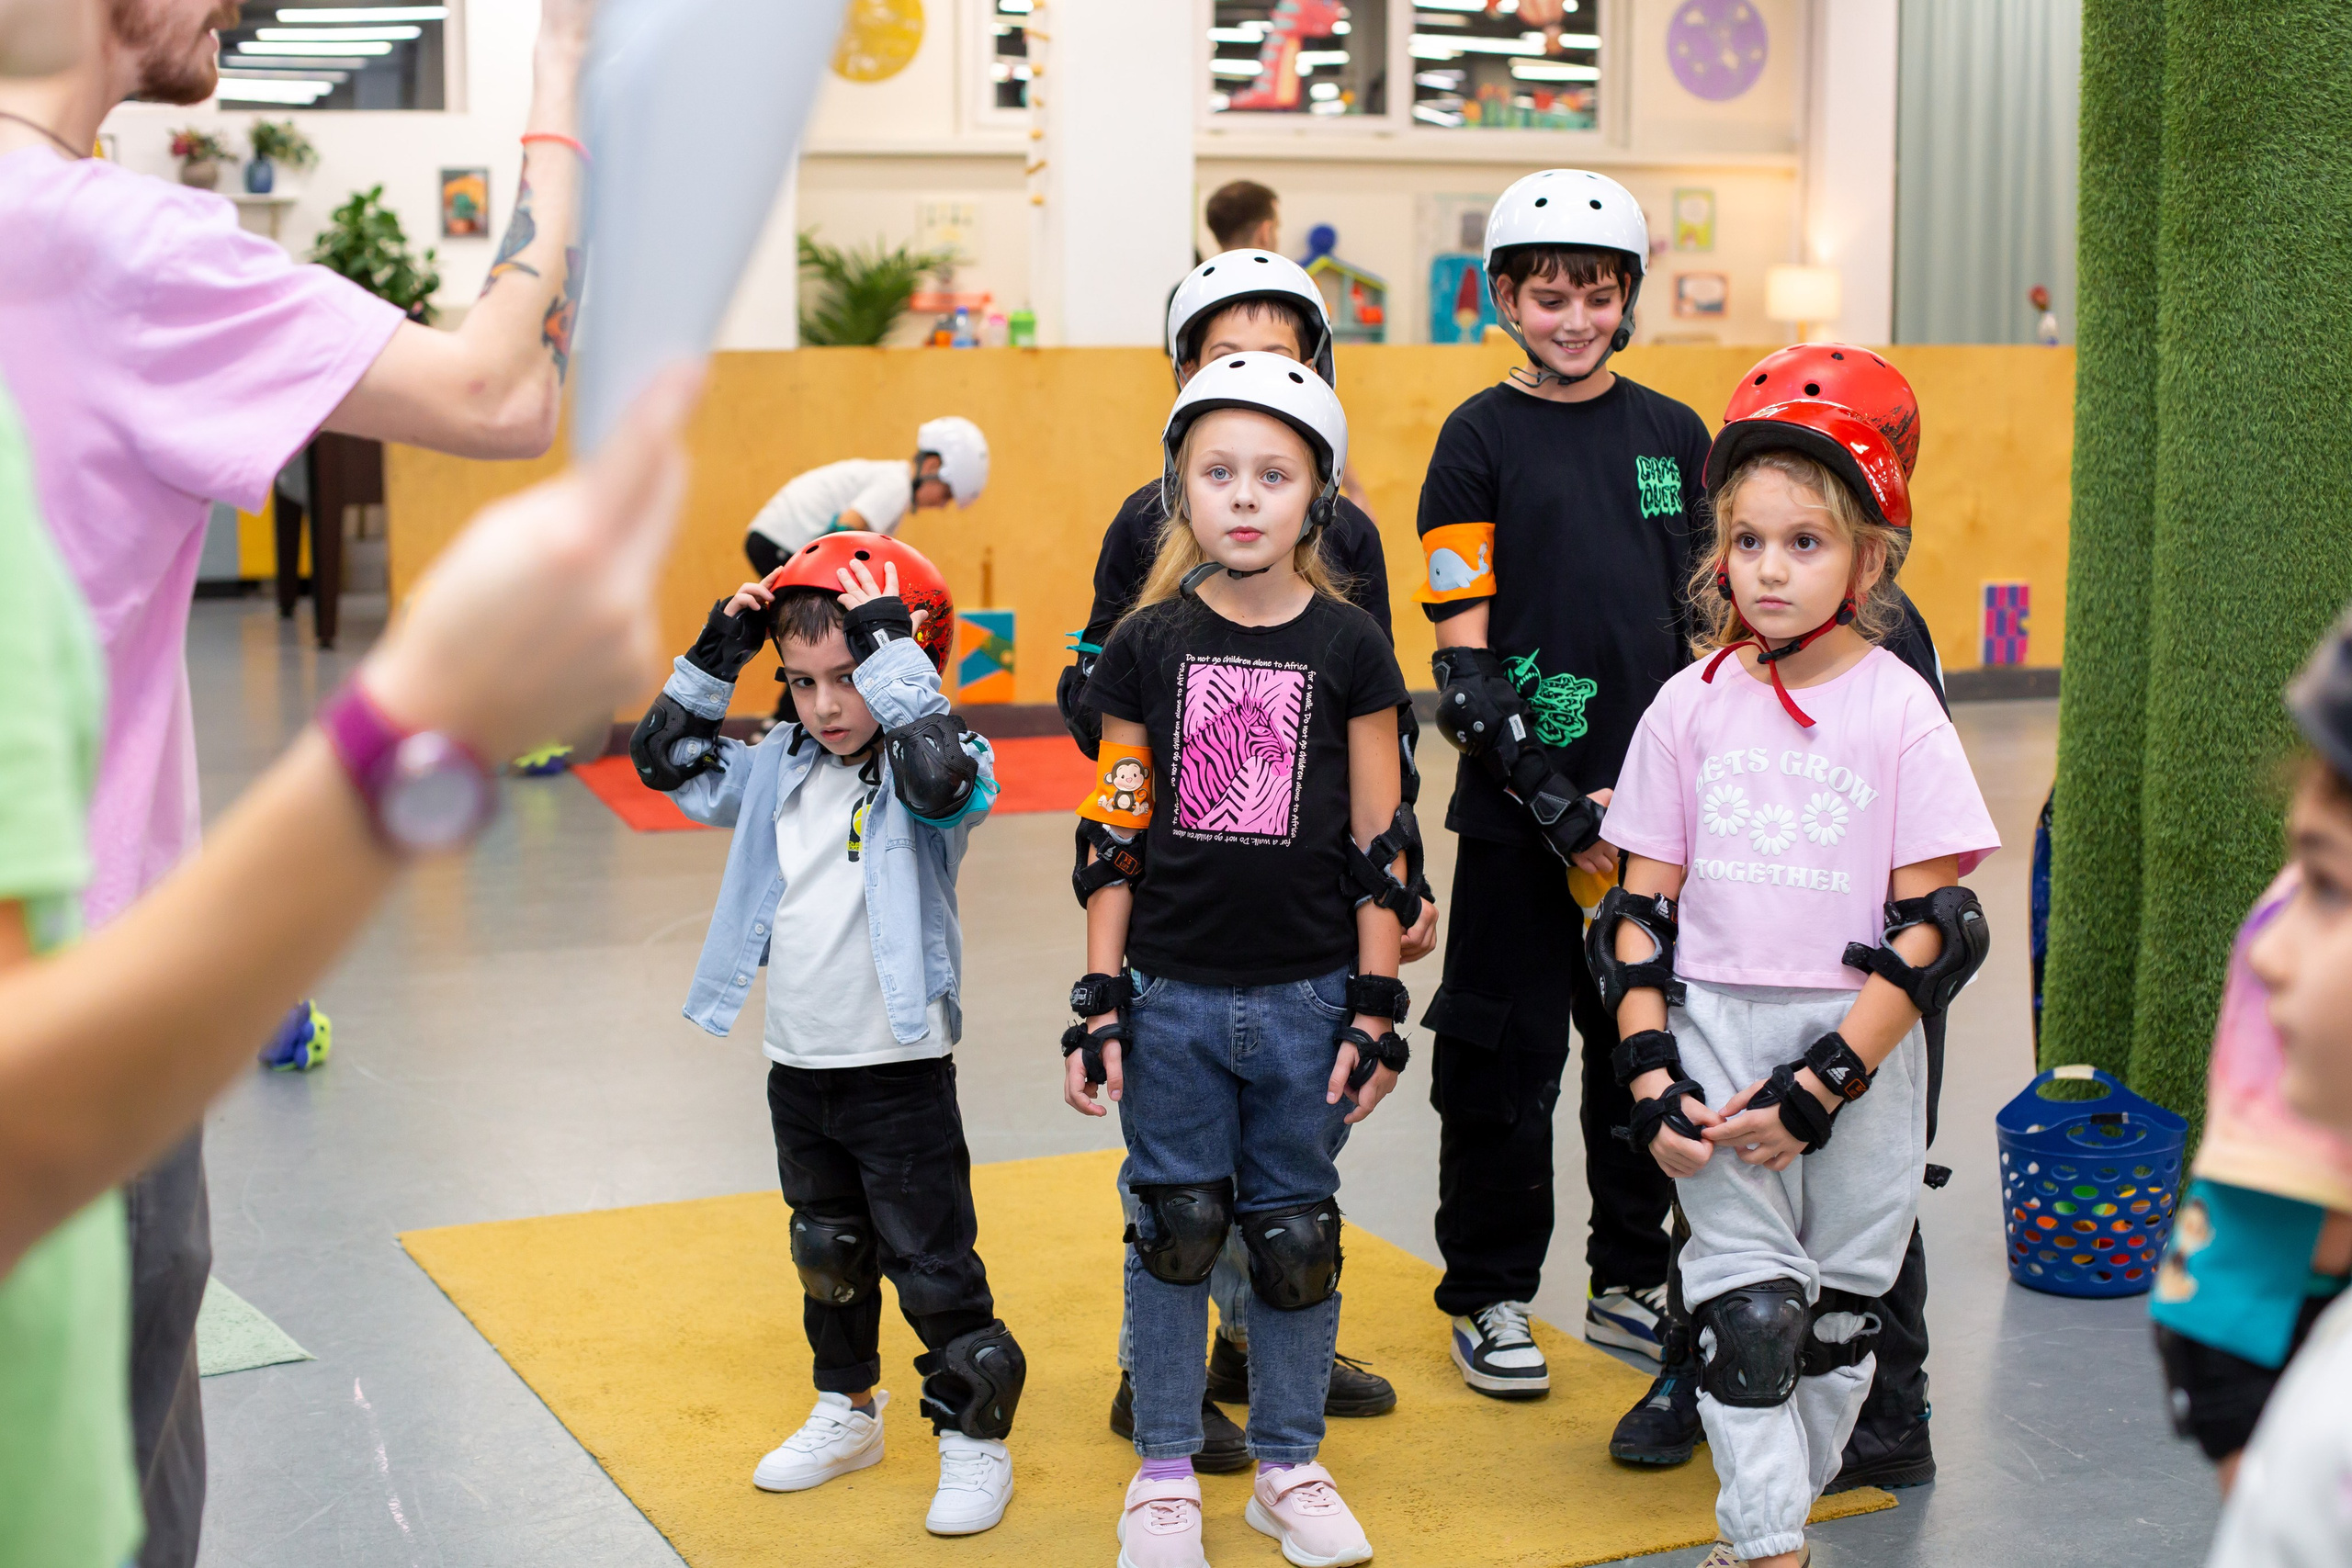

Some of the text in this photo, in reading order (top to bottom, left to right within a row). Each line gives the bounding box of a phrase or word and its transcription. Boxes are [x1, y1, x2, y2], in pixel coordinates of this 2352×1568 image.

[1185, 653, 1196, 661] Do
[1212, 657, 1222, 665] go
[1222, 655, 1251, 665] children
[1252, 659, 1272, 667] alone
[1283, 661, 1308, 671] Africa
[1176, 661, 1186, 687] Africa
[1307, 670, 1317, 682] for
[1176, 688, 1183, 698] to
[1172, 720, 1181, 750] children
[1172, 750, 1182, 761] go
[1291, 713, 1312, 839] Do not go children alone to Africa
[1779, 750, 1880, 812] GROW
[1171, 816, 1179, 826] to
[1213, 832, 1224, 841] go
[1224, 835, 1238, 843] not
[1238, 836, 1250, 845] Do
[1279, 838, 1292, 848] for
[1693, 857, 1851, 896] TOGETHER
